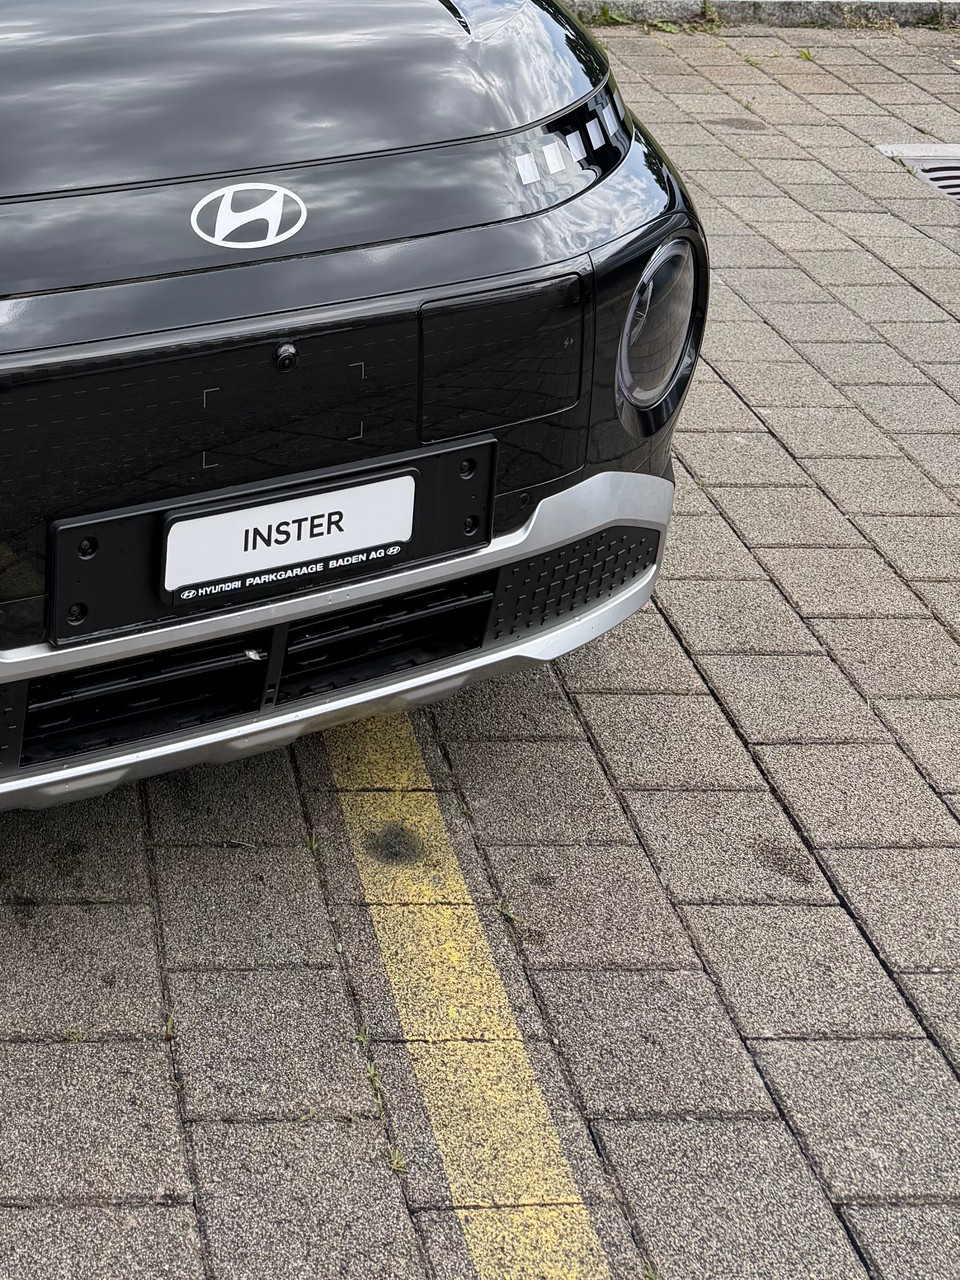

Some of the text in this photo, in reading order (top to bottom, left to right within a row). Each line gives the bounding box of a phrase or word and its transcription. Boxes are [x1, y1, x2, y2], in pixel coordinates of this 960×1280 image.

[243, 510, 345, 552] INSTER
[198, 549, 385, 596] HYUNDAI PARKGARAGE BADEN AG
